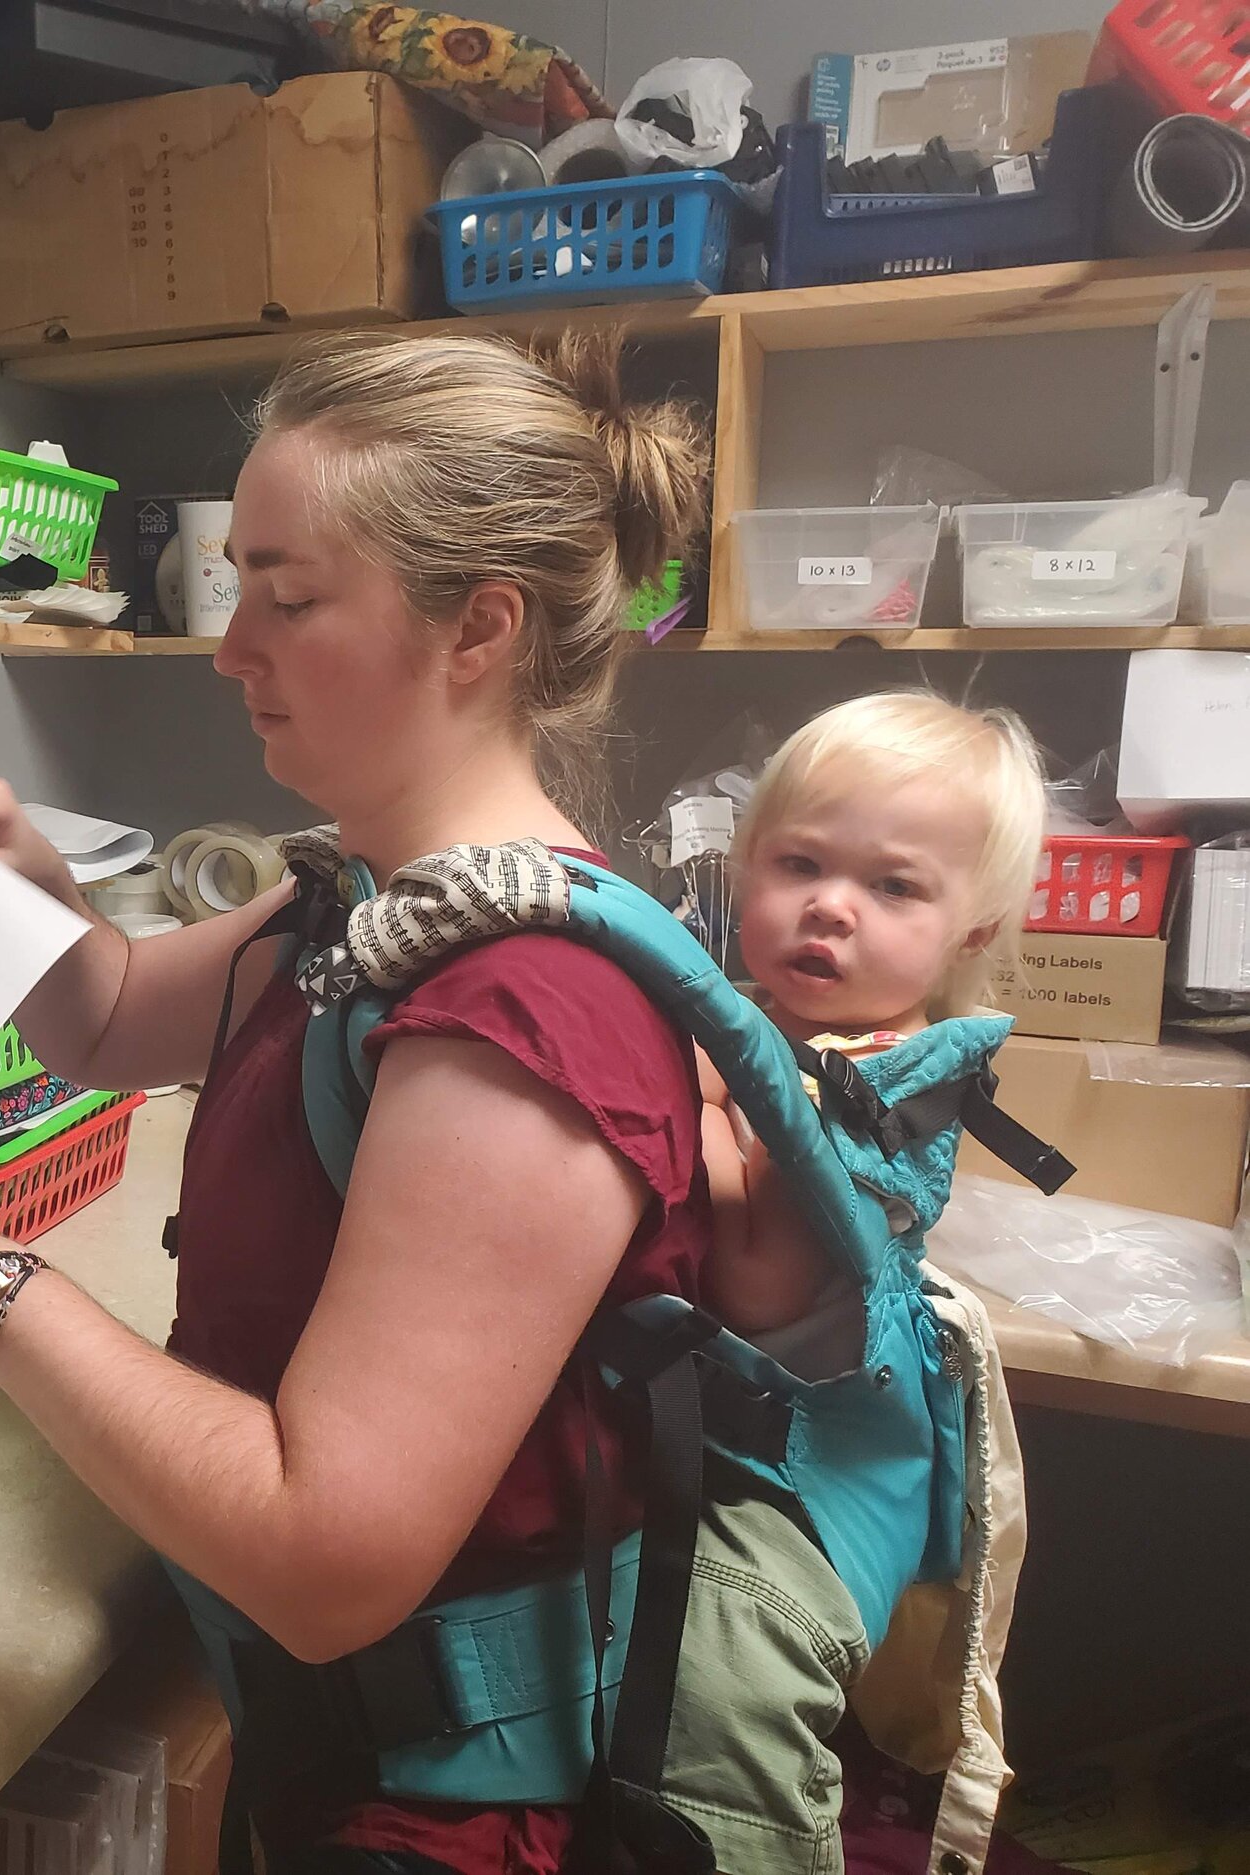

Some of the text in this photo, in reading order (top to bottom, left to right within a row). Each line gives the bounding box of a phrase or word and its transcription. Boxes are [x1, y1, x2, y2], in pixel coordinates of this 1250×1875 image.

[160, 133, 168, 143] 0
[162, 169, 170, 178] 2
[163, 186, 171, 196] 3
[131, 203, 146, 214] 10
[163, 203, 172, 213] 4
[131, 220, 147, 231] 20
[165, 221, 173, 231] 5
[165, 238, 173, 249] 6
[166, 256, 174, 266] 7
[167, 273, 175, 283] 8
[168, 290, 176, 301] 9
[138, 514, 169, 524] TOOL
[139, 524, 168, 534] SHED
[810, 565, 823, 576] 10
[841, 564, 856, 577] 13
[1049, 559, 1059, 571] 8
[1078, 559, 1096, 572] 12
[1050, 954, 1103, 969] Labels
[1064, 991, 1112, 1006] labels
